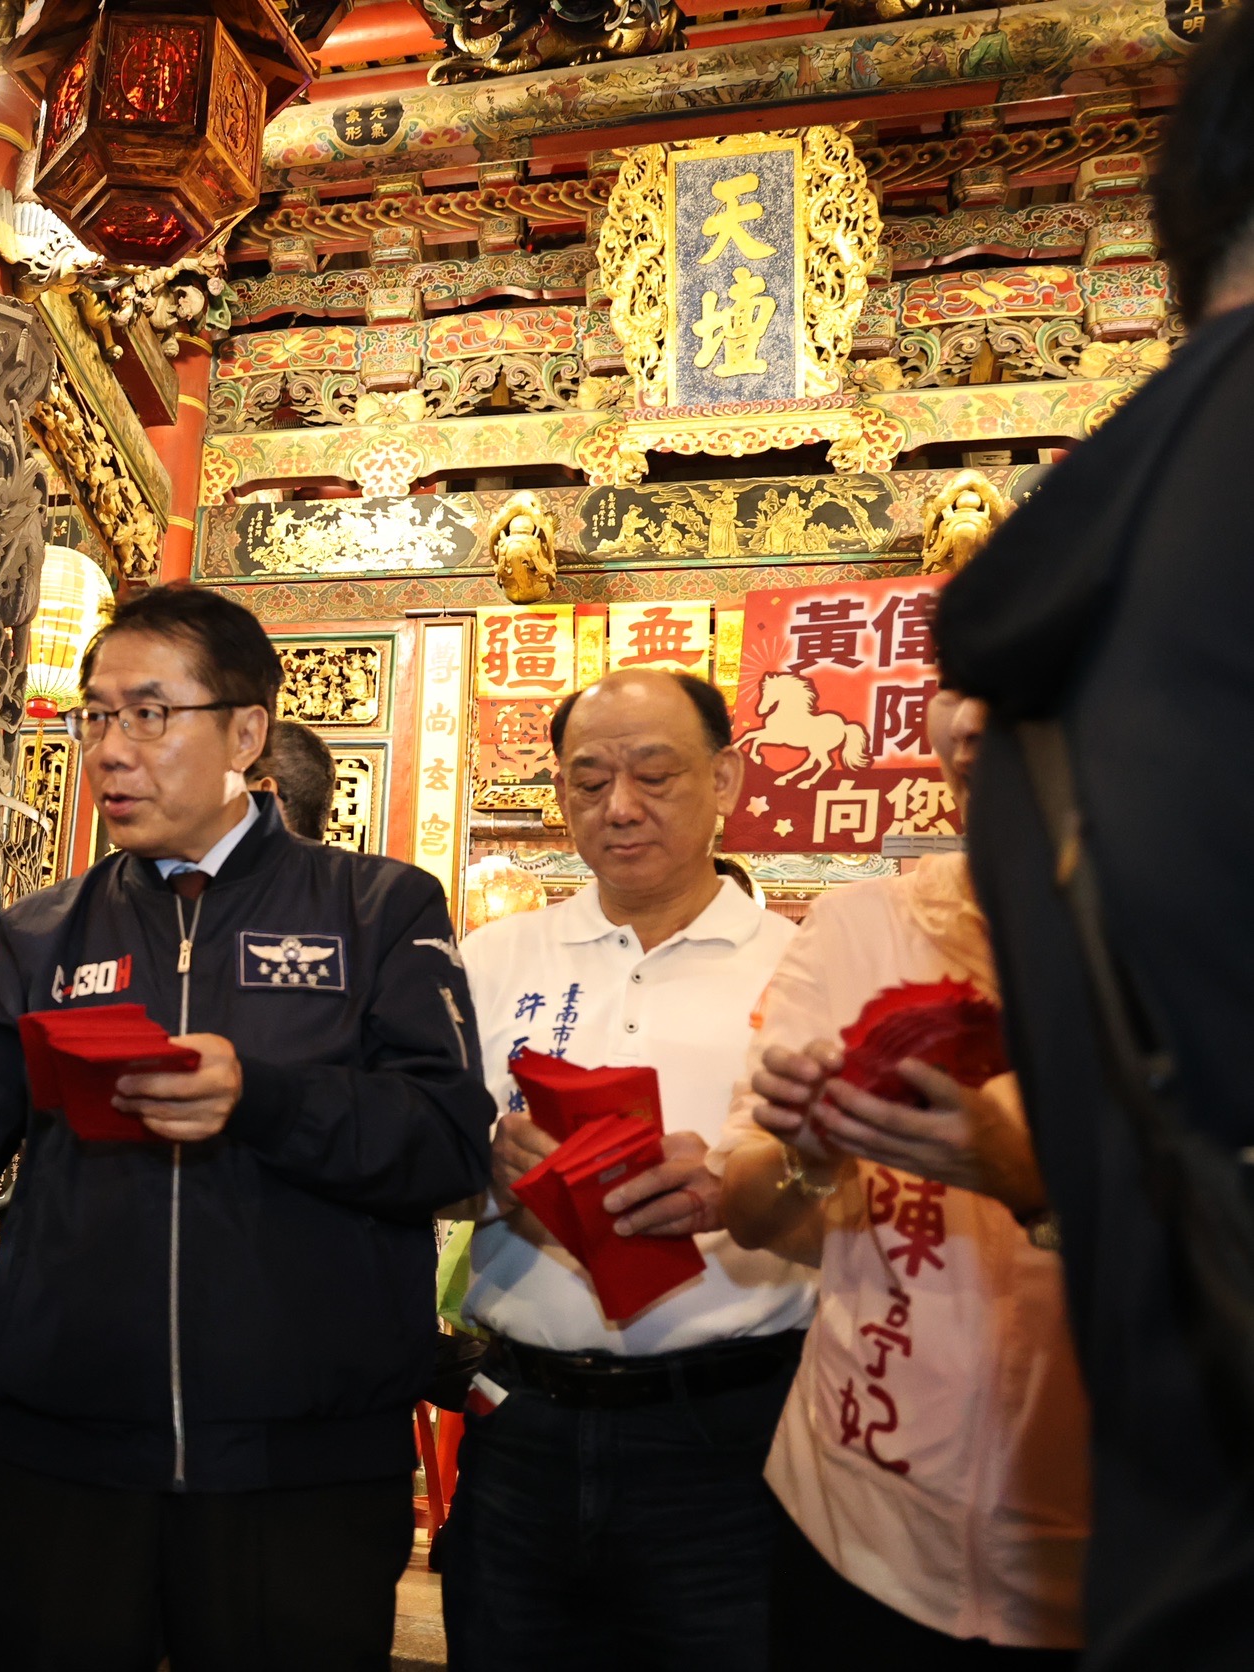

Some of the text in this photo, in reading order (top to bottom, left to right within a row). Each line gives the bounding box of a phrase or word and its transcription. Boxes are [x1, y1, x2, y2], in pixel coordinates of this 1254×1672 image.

[692, 172, 777, 378] 天壇
[812, 777, 958, 844] 向您
[840, 1166, 946, 1476] 陳亭妃
